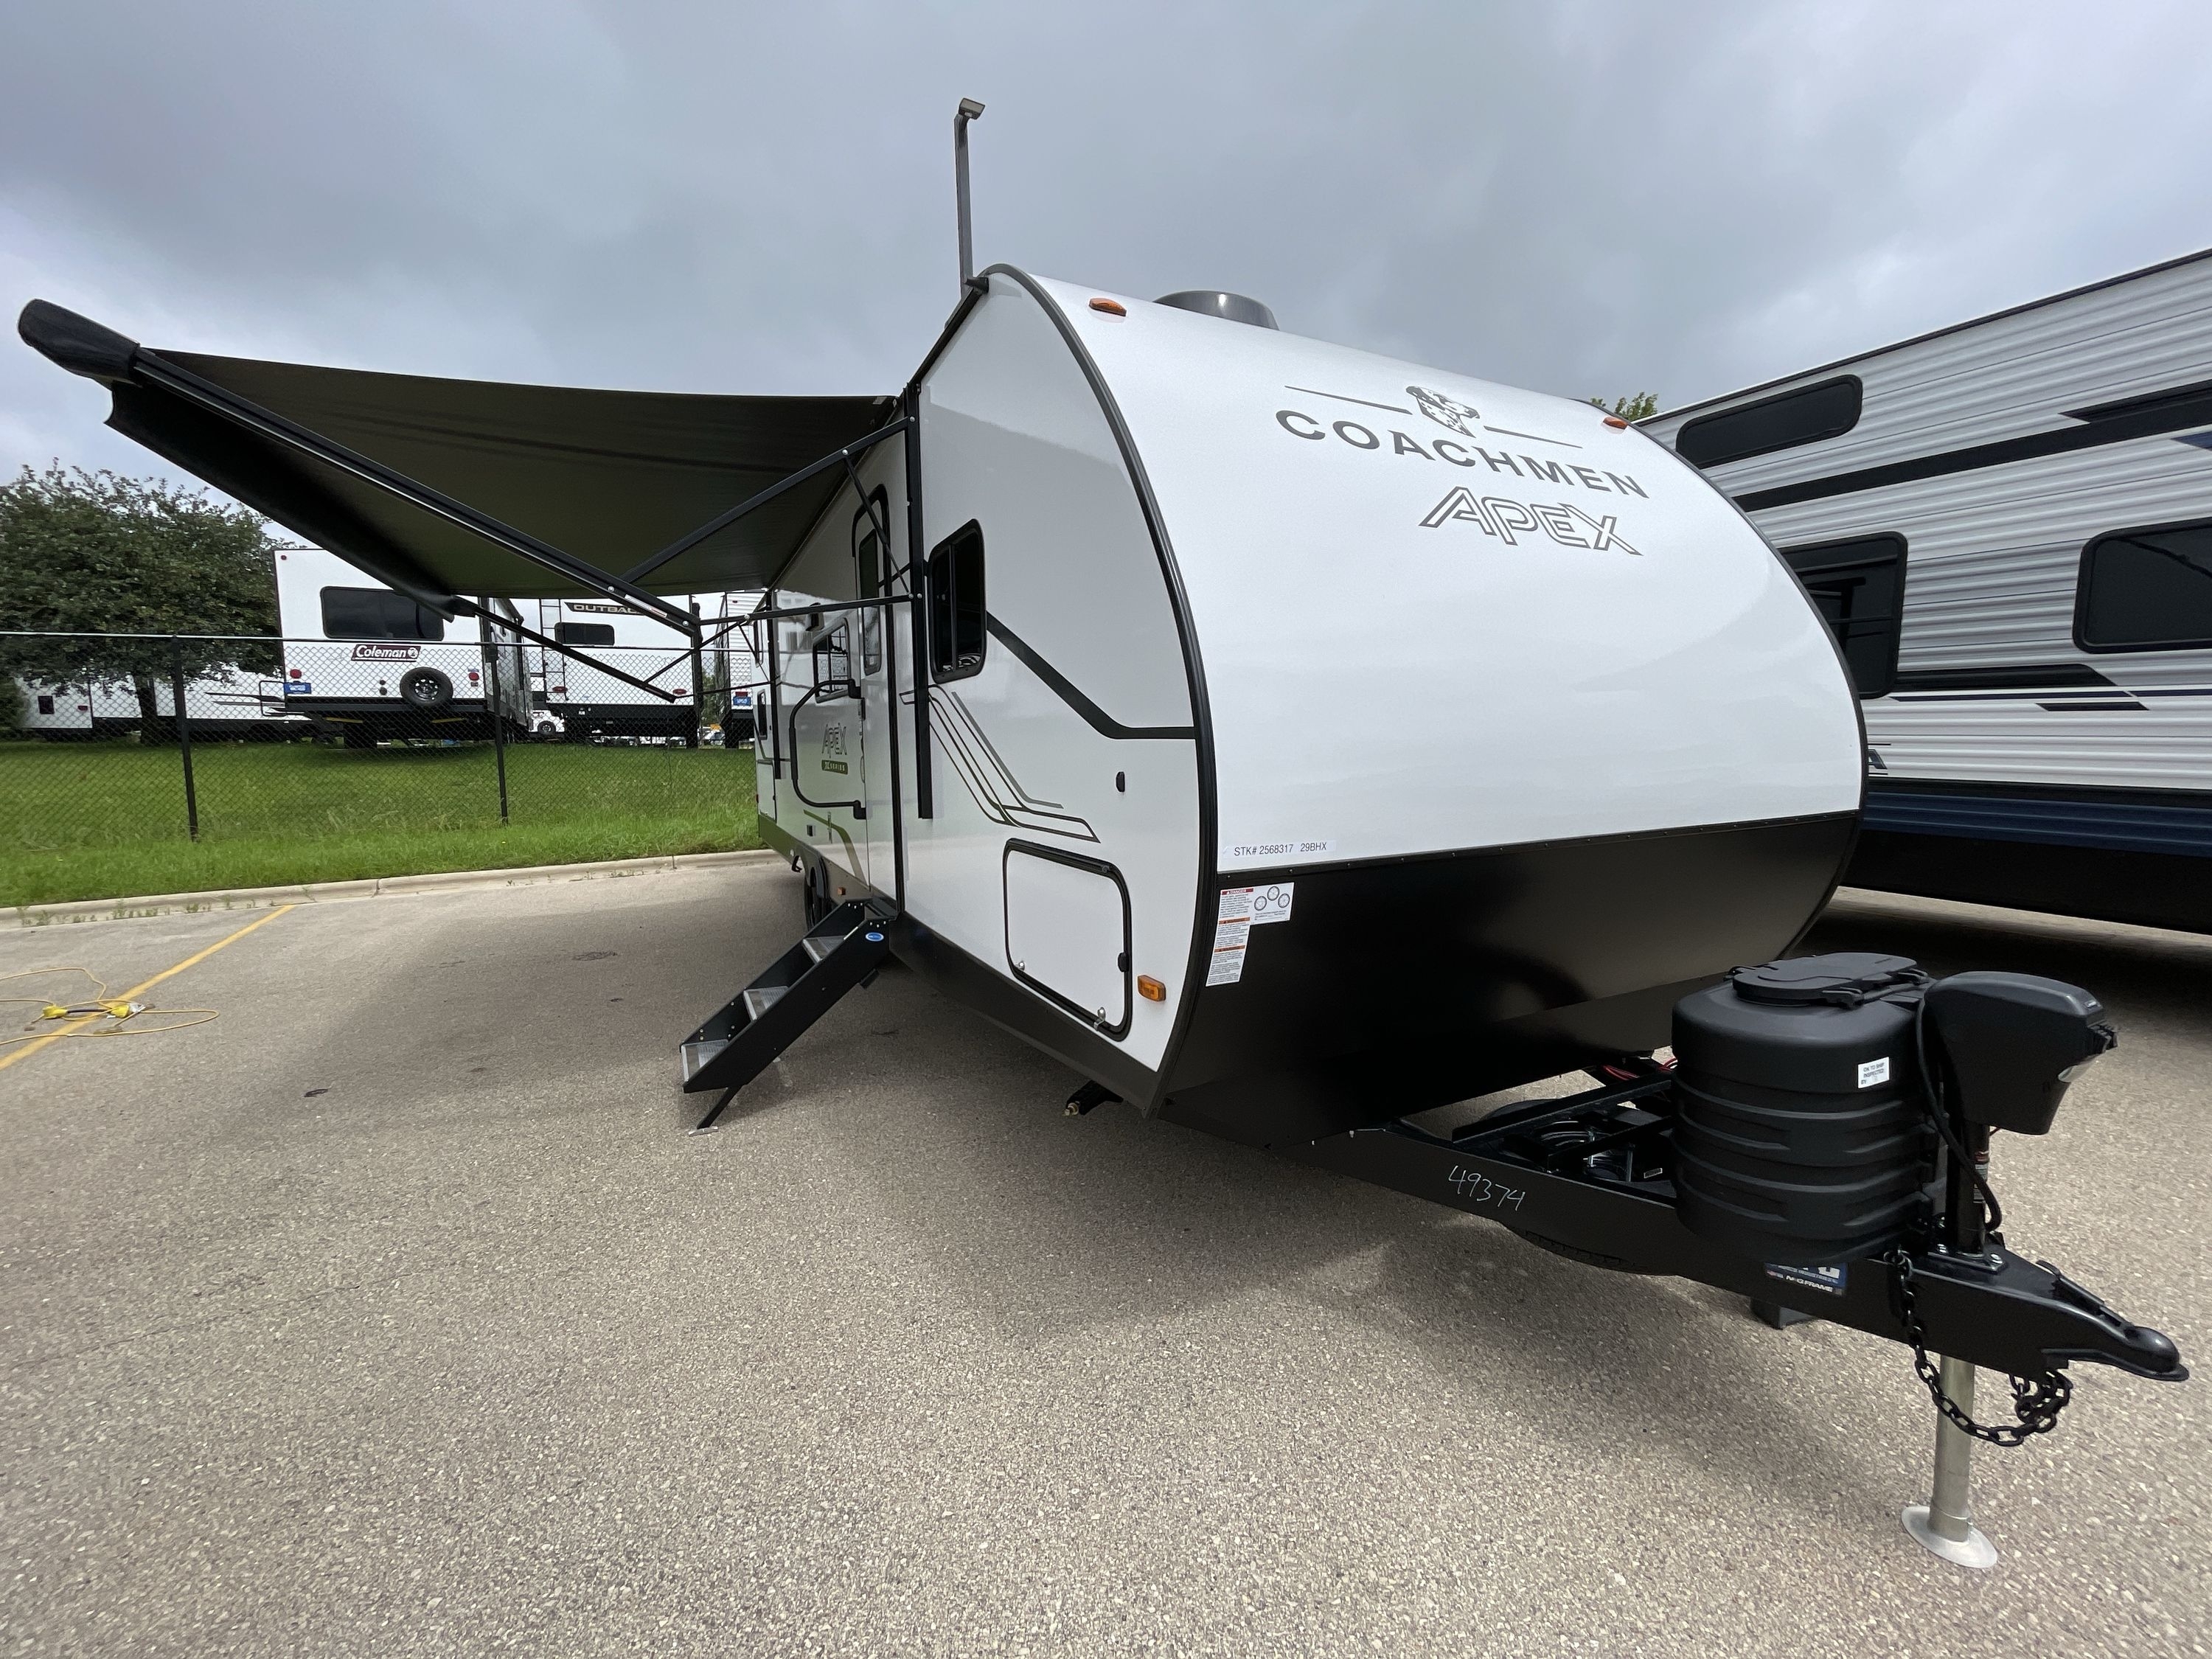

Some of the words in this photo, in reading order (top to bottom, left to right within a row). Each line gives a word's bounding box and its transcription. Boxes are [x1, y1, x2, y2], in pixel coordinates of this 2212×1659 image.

[1276, 409, 1649, 498] COACHMEN
[1418, 486, 1644, 556] APEX
[574, 604, 639, 615] OUTBAC
[356, 644, 406, 658] Coleman
[821, 723, 847, 759] APEX
[1234, 846, 1257, 856] STK#
[1259, 844, 1294, 855] 2568317
[1300, 842, 1327, 852] 29BHX
[1448, 1165, 1526, 1211] 49374
[1804, 1279, 1833, 1293] FRAME
